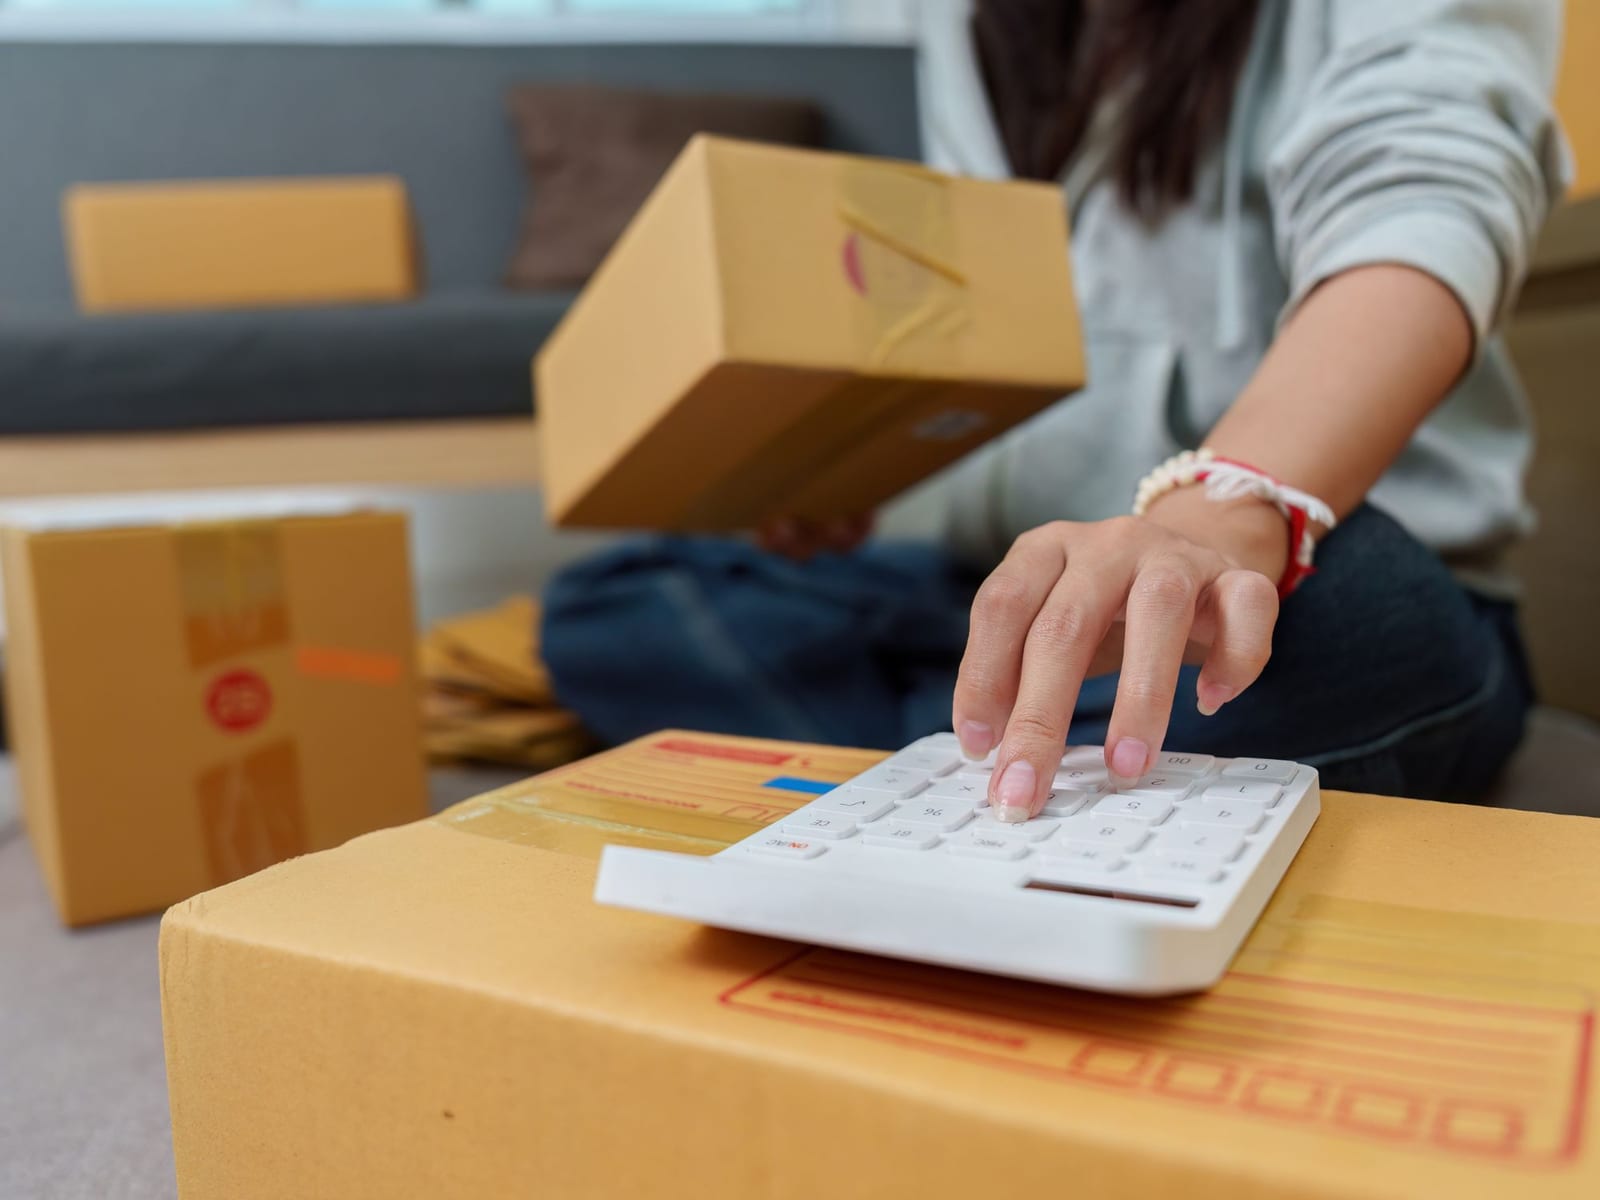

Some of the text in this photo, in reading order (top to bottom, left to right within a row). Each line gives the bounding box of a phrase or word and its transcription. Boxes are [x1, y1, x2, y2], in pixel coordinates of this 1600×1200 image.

[1151, 778, 1167, 786] 2
[1239, 785, 1248, 793] 1
[1127, 802, 1141, 810] 5
[1217, 810, 1232, 818] 4
[810, 819, 831, 827] CE
